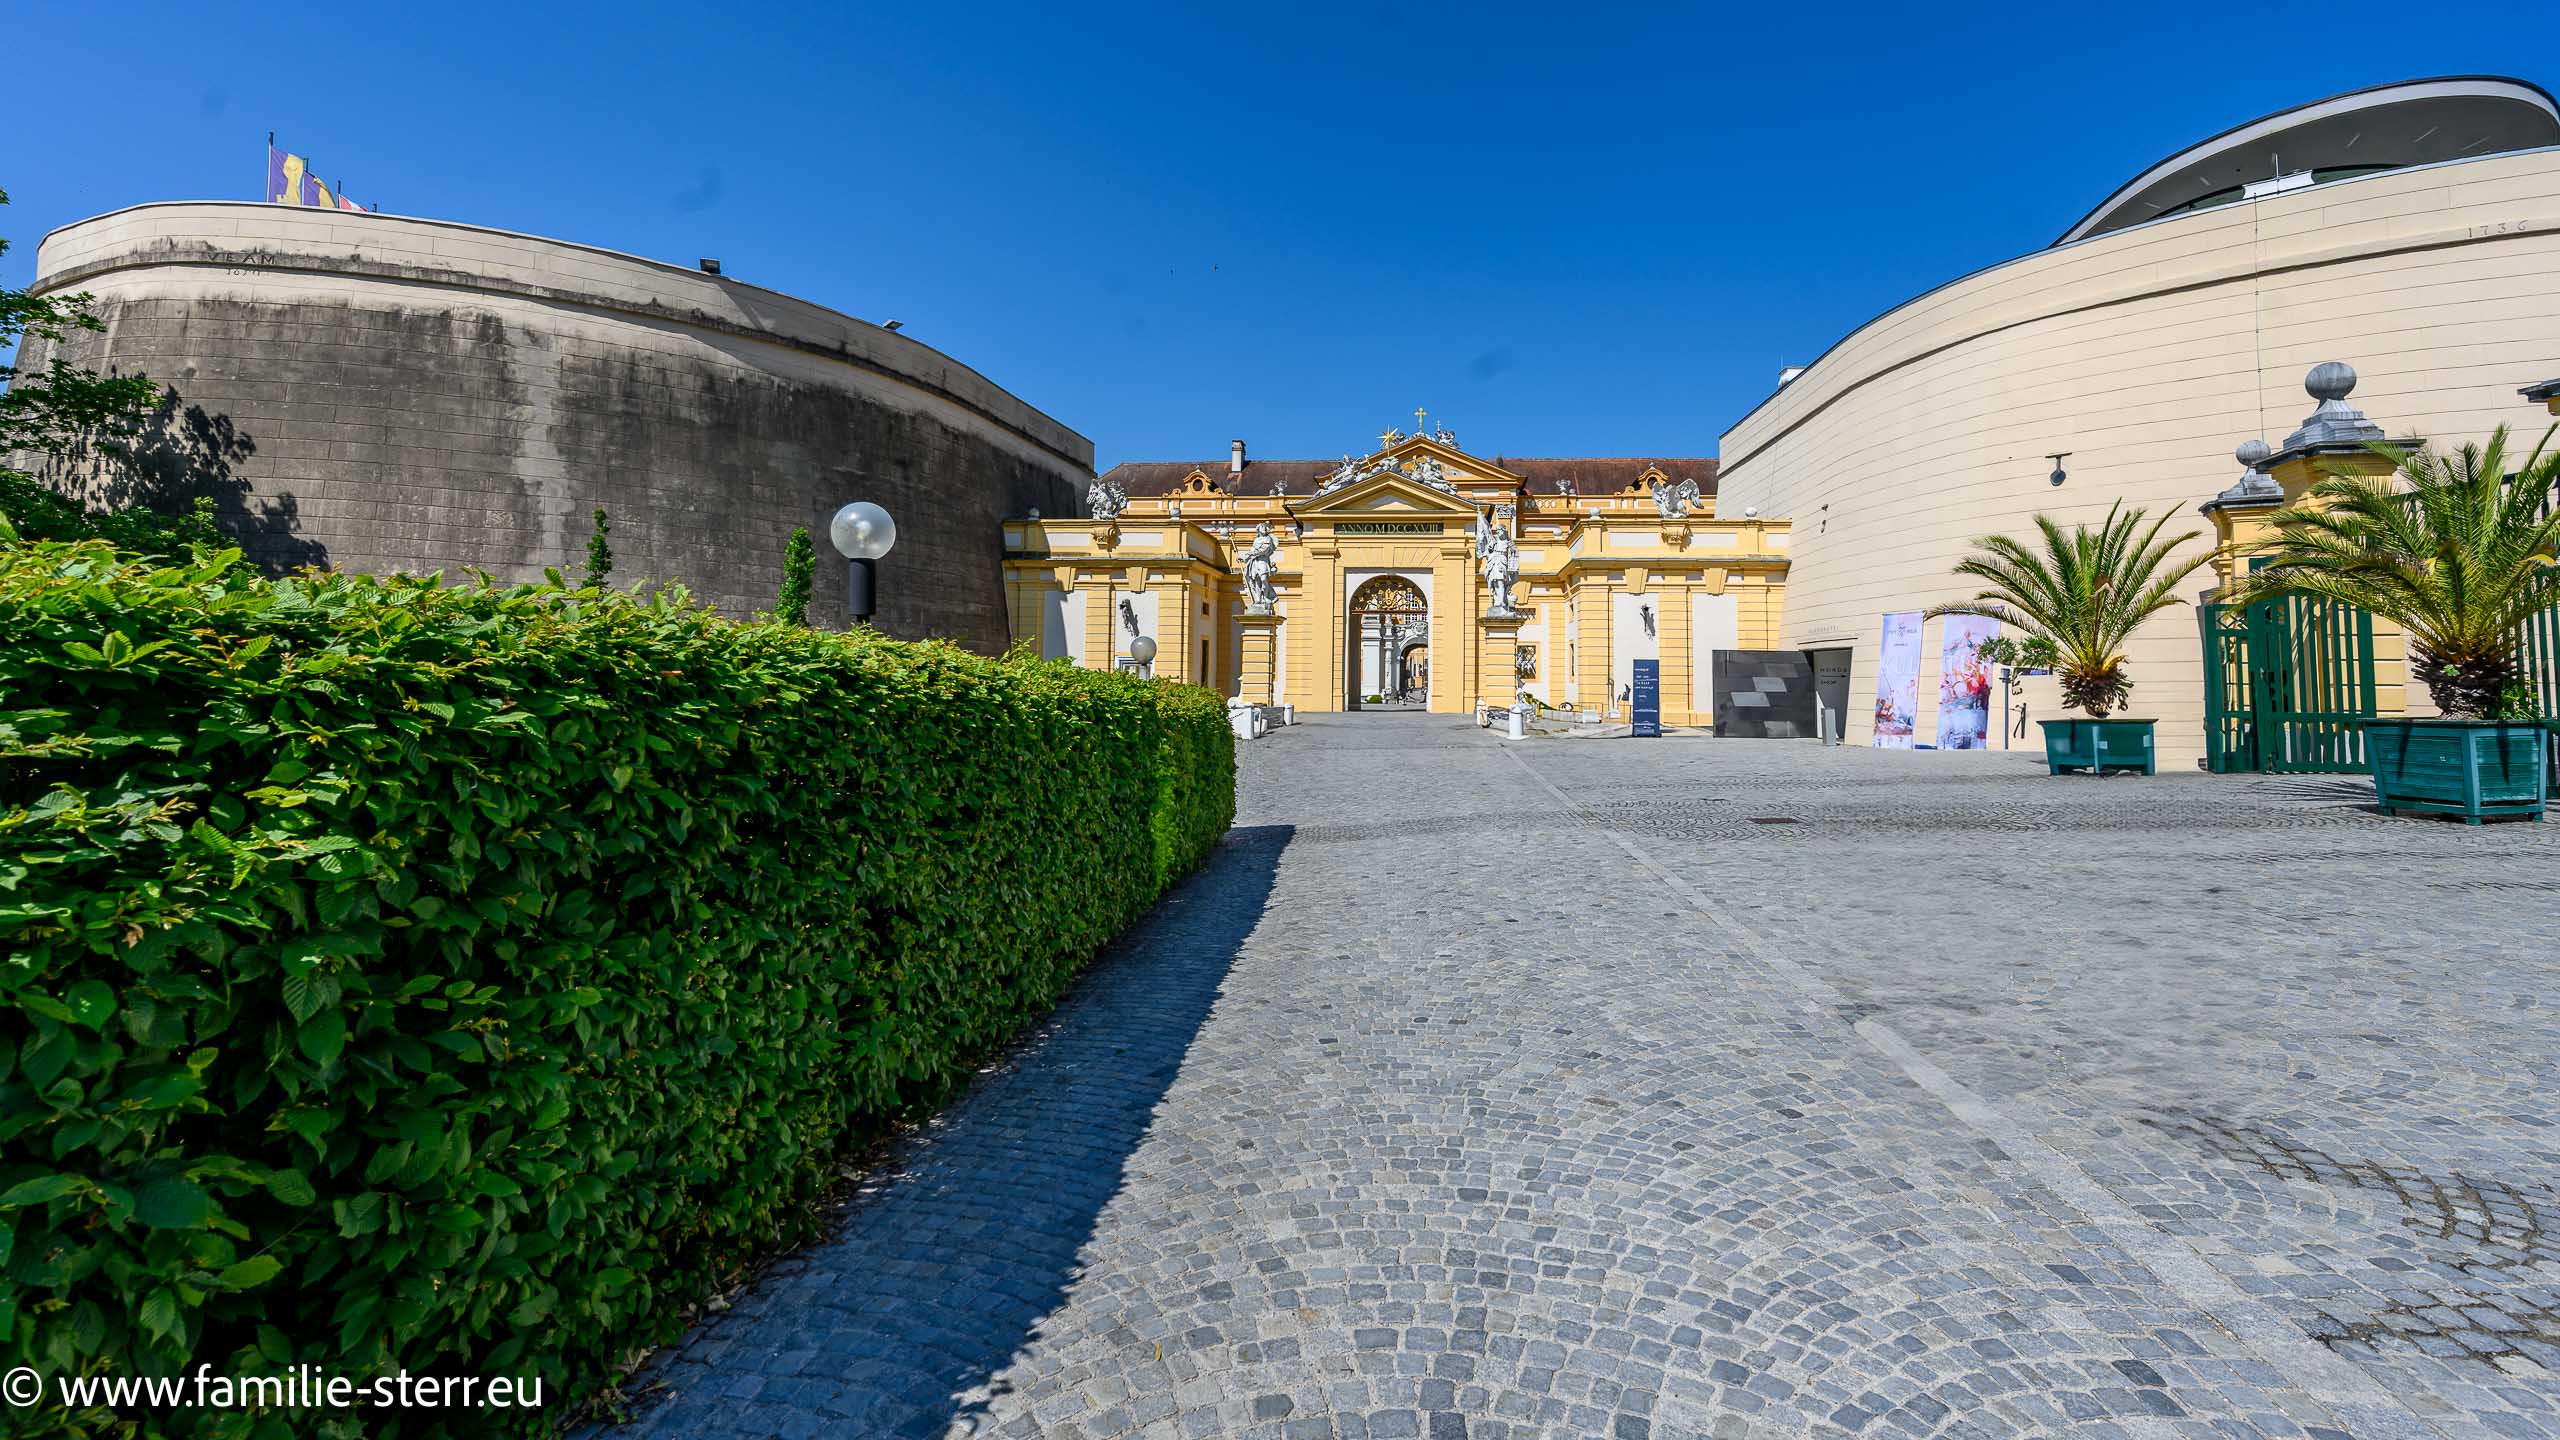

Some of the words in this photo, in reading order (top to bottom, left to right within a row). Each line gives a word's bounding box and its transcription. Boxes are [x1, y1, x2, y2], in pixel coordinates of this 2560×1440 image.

[2467, 219, 2529, 238] 1736
[1341, 523, 1374, 534] ANNO
[1375, 523, 1440, 534] MDCCXVIII
